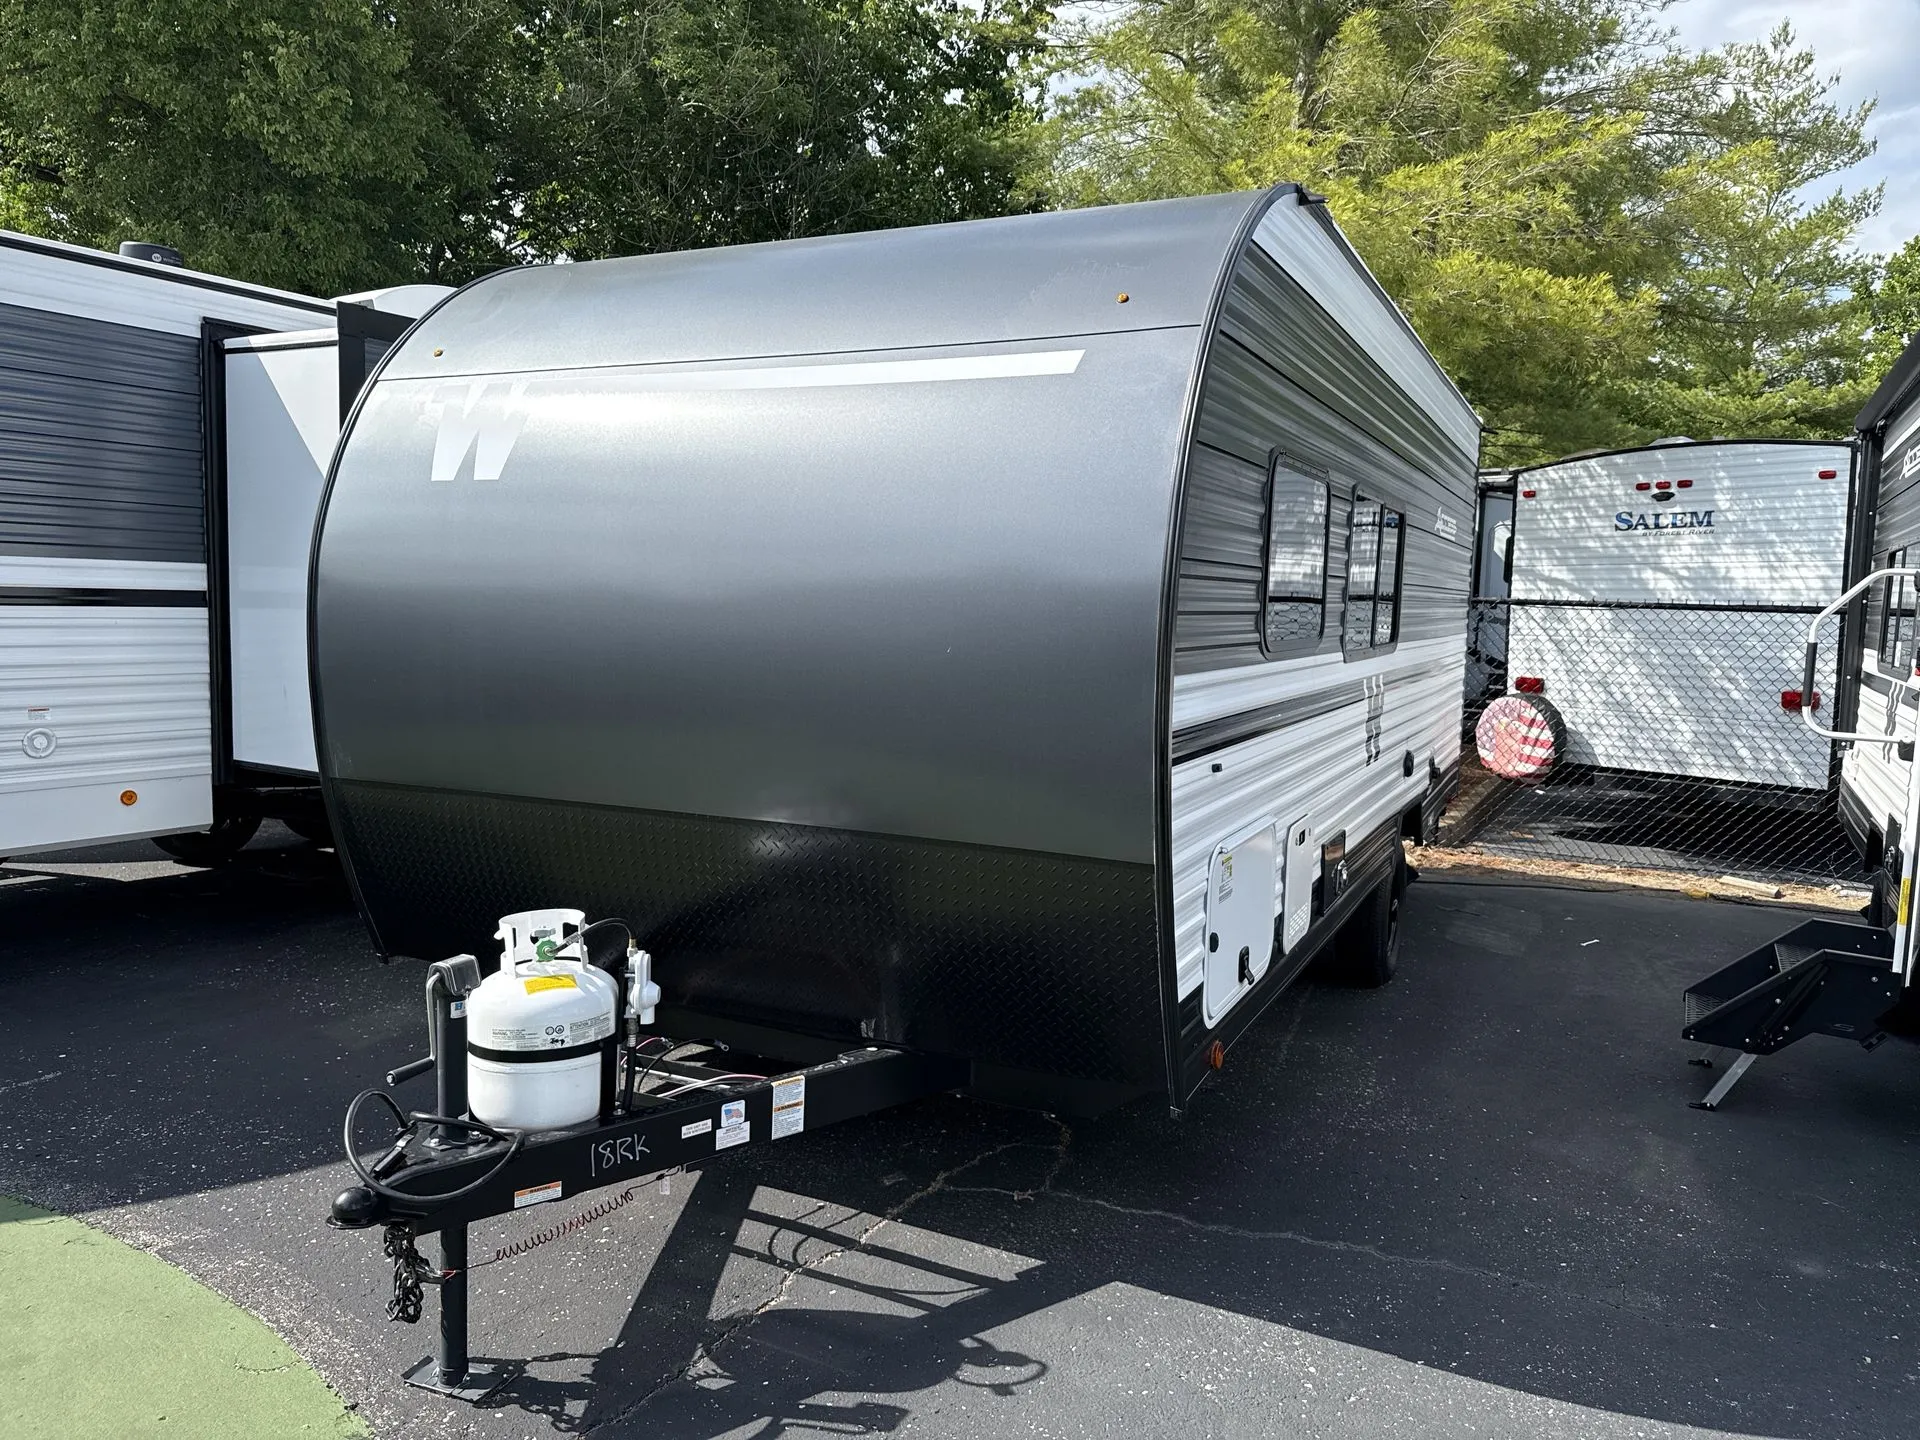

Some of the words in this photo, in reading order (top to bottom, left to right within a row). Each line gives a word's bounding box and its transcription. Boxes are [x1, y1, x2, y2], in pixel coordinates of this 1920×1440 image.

[1614, 510, 1715, 532] SALEM
[1654, 529, 1685, 537] FOREST
[1688, 528, 1715, 536] RIVER
[590, 1133, 650, 1177] 18RK
